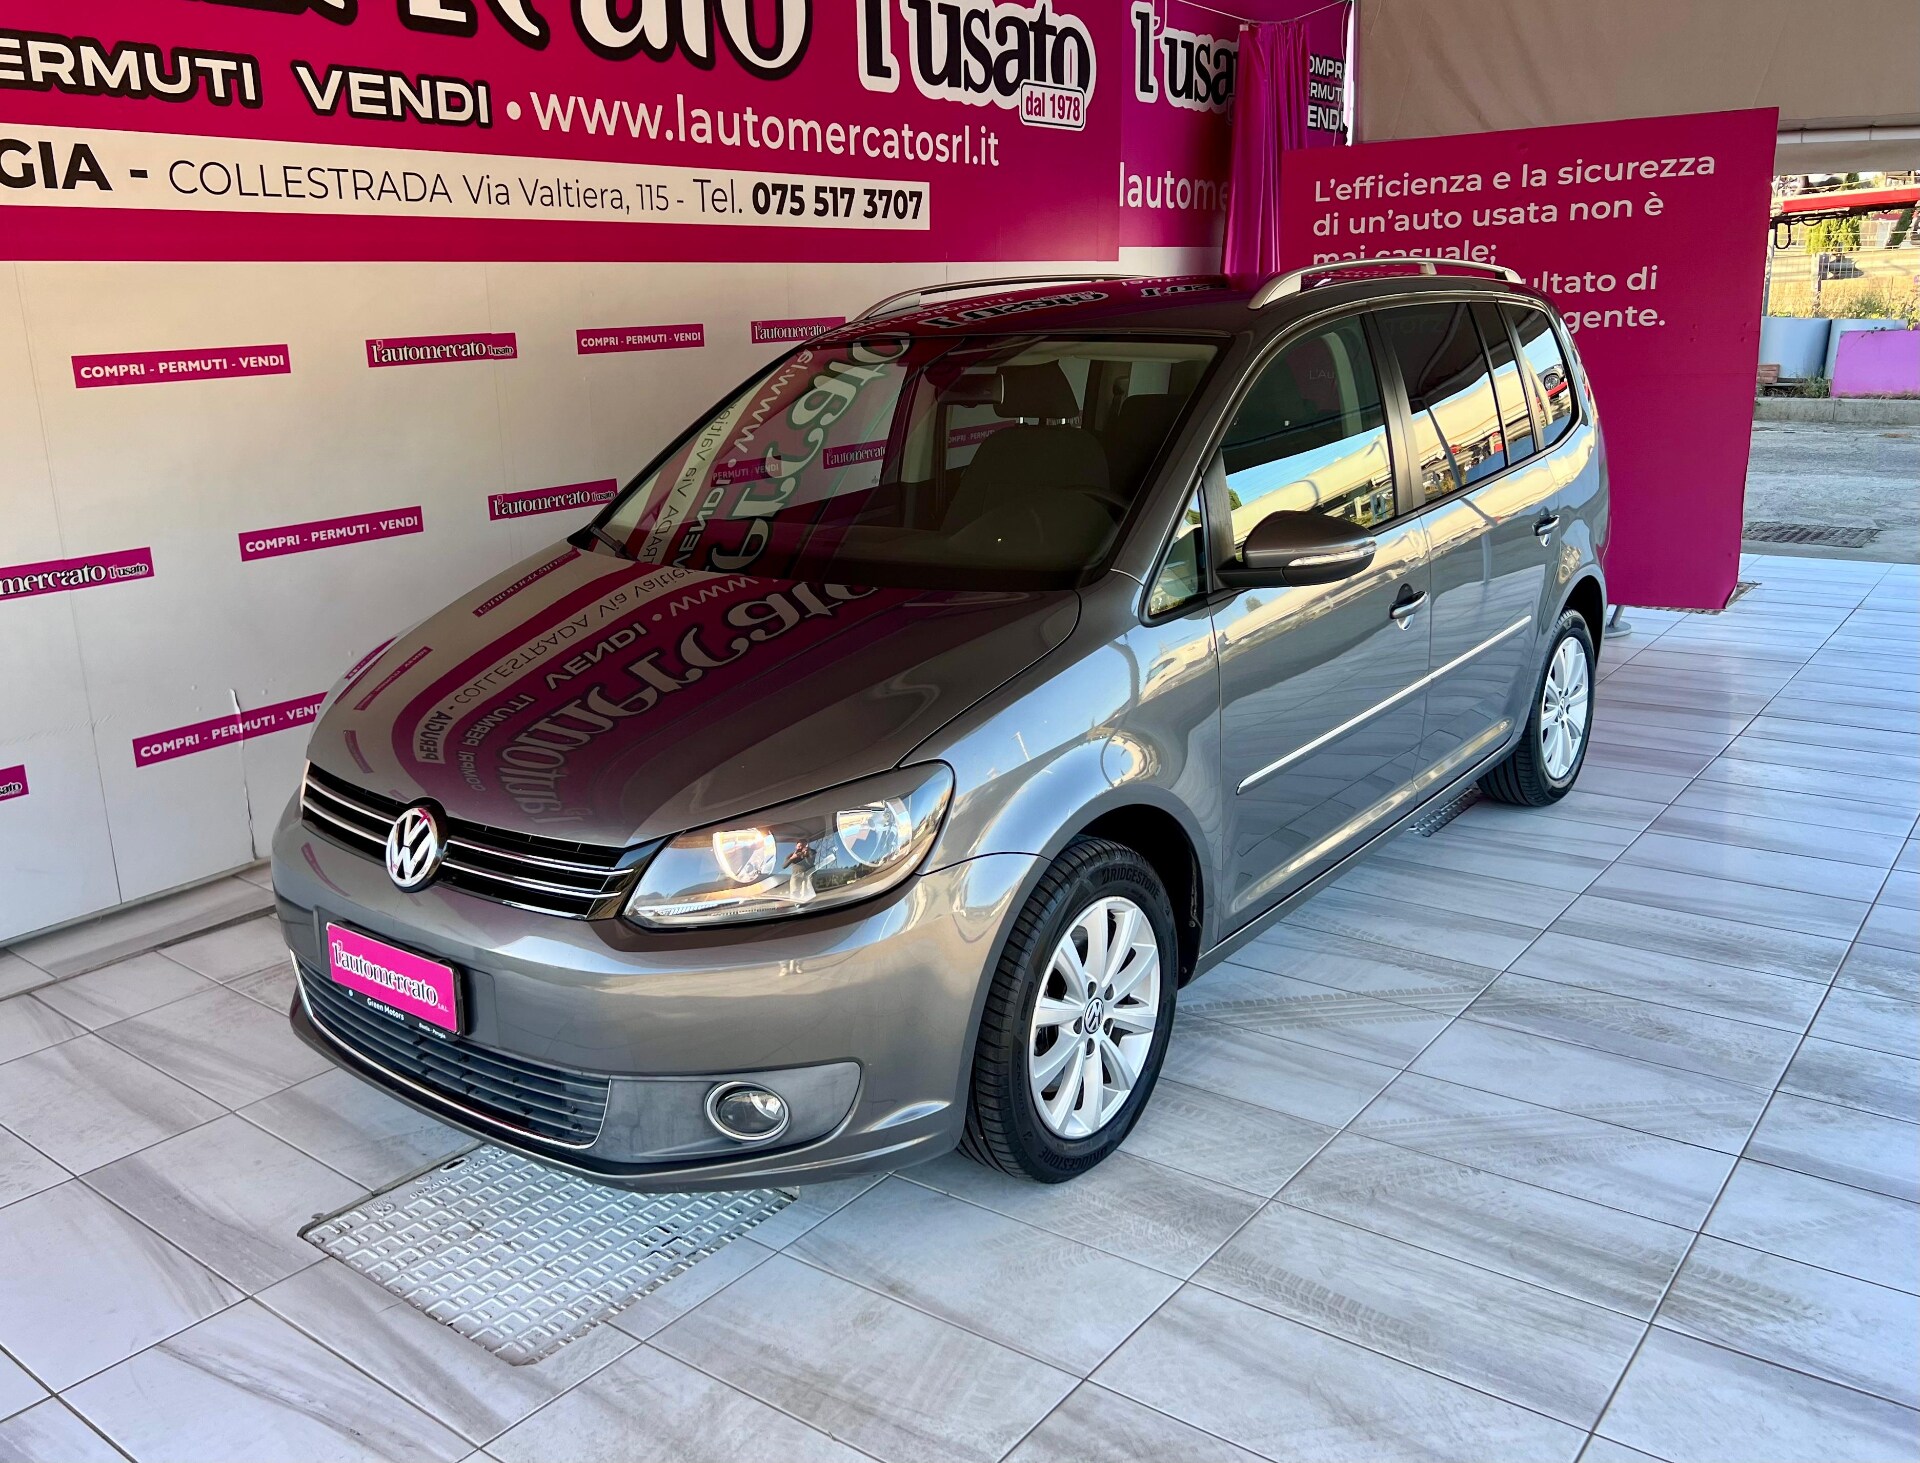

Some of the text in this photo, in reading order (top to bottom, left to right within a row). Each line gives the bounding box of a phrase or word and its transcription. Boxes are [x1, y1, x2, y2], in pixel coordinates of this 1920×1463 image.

[294, 64, 491, 126] VENDI
[529, 91, 1000, 167] www.lautomercatosrl.it
[1025, 91, 1082, 122] dal 1978
[0, 137, 114, 192] GIA
[168, 159, 453, 204] COLLESTRADA
[462, 174, 511, 206] Via
[518, 177, 631, 215] Valtiera,
[635, 183, 670, 212] 115
[692, 177, 744, 214] Tel.
[752, 181, 806, 217] 075
[813, 184, 856, 219] 517
[862, 188, 924, 220] 3707
[1315, 155, 1716, 203] L'efficienza e la sicurezza
[1313, 191, 1665, 237] di un'auto usata non è
[1626, 264, 1659, 291] di
[371, 339, 487, 364] l'automercato
[580, 334, 619, 348] COMPRI
[626, 333, 667, 346] PERMUTI
[673, 331, 701, 343] VENDI
[80, 363, 146, 379] COMPRI
[158, 358, 228, 374] PERMUTI
[239, 354, 285, 369] VENDI
[493, 490, 591, 516] l'automercato
[245, 534, 300, 553] COMPRI
[311, 523, 370, 542] PERMUTI
[379, 515, 418, 531] VENDI
[139, 733, 200, 758] COMPRI
[211, 714, 276, 741] PERMUTI
[331, 940, 439, 1006] l'automercato
